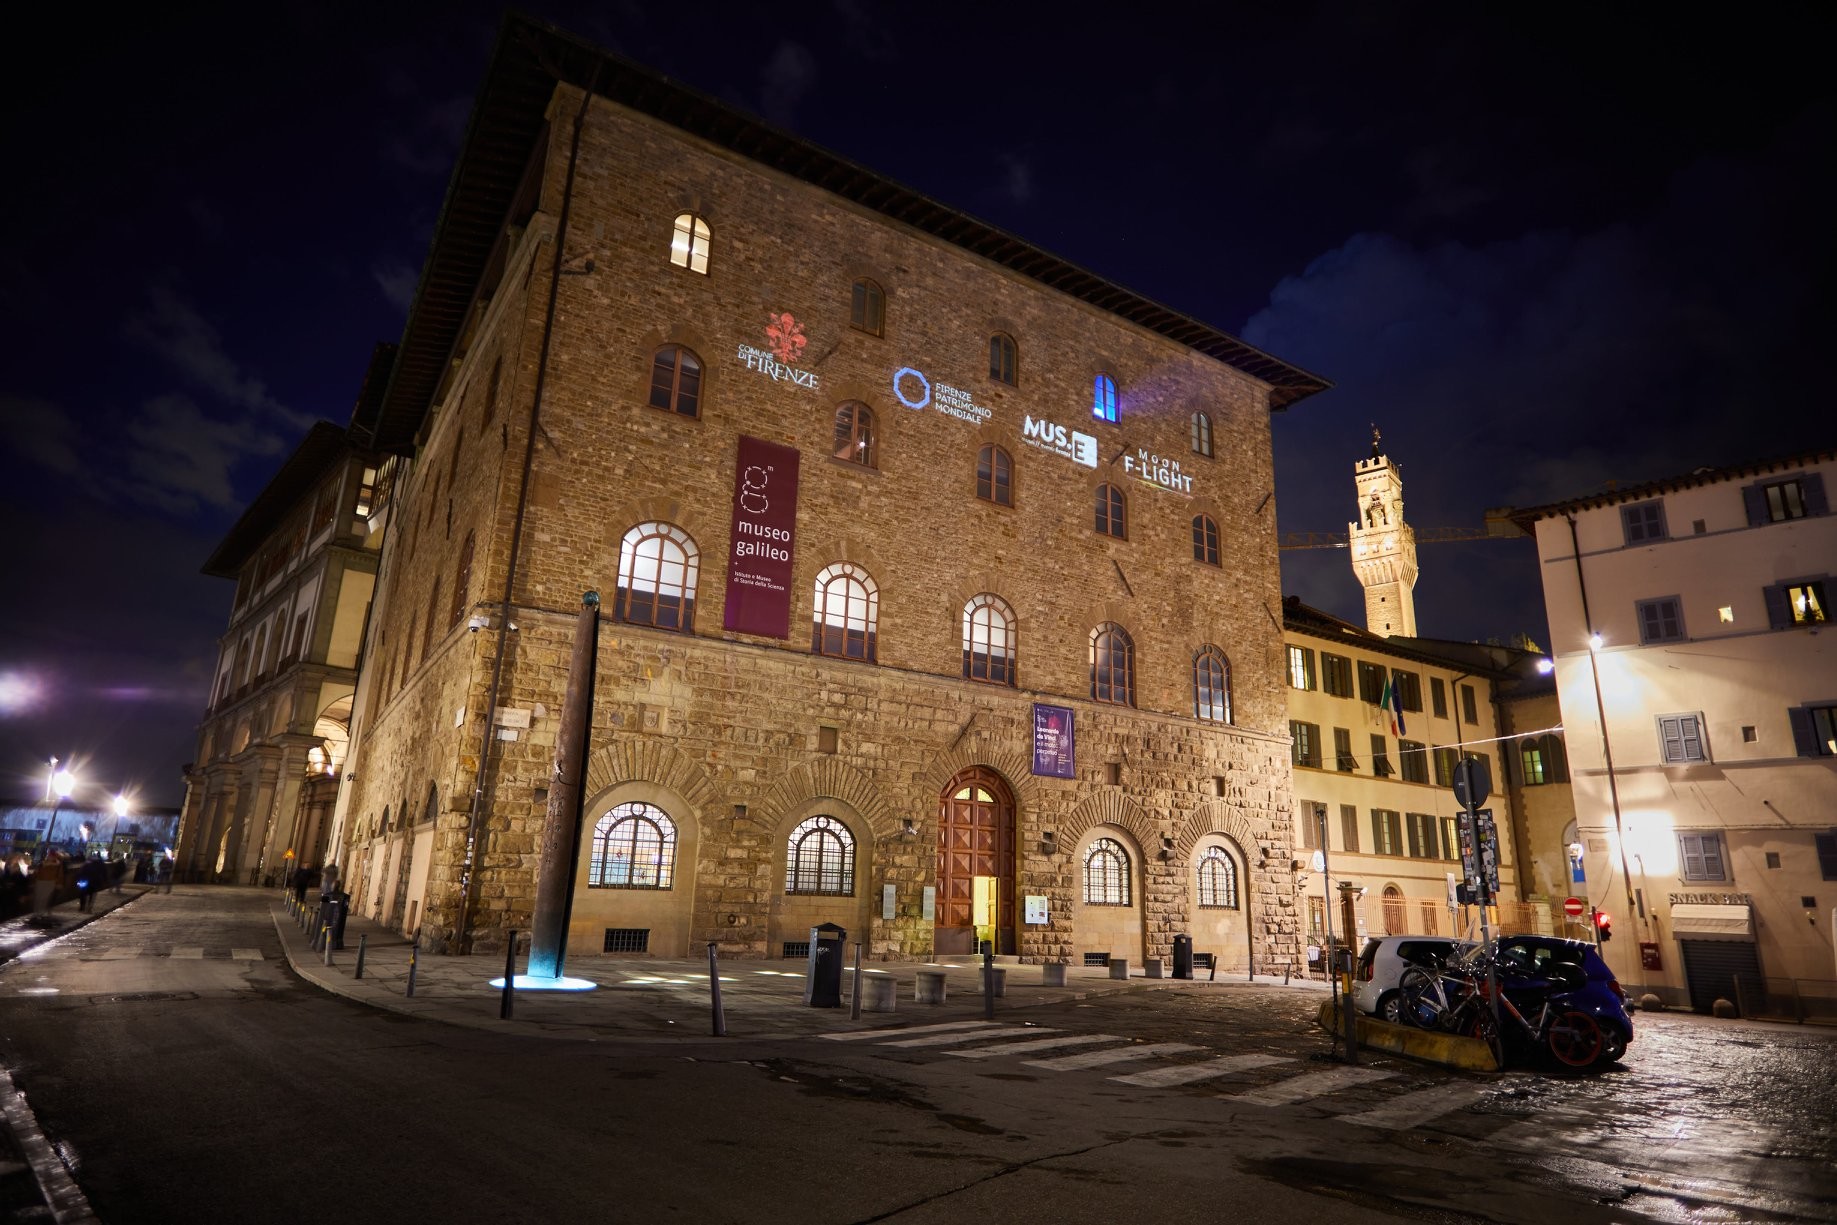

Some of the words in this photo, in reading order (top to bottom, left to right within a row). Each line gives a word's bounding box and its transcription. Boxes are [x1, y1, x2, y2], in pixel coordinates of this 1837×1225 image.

[738, 343, 774, 361] COMUNE
[746, 354, 820, 390] FIRENZE
[935, 382, 972, 402] FIRENZE
[935, 392, 992, 418] PATRIMONIO
[935, 401, 982, 425] MONDIALE
[1138, 448, 1180, 472] MOON
[1124, 455, 1193, 494] F-LIGHT
[738, 520, 790, 542] museo
[736, 541, 789, 562] galileo
[739, 577, 754, 585] Storia
[754, 579, 767, 588] della
[767, 582, 785, 591] Scienza
[756, 573, 772, 583] Museo
[1669, 893, 1717, 905] SNACK
